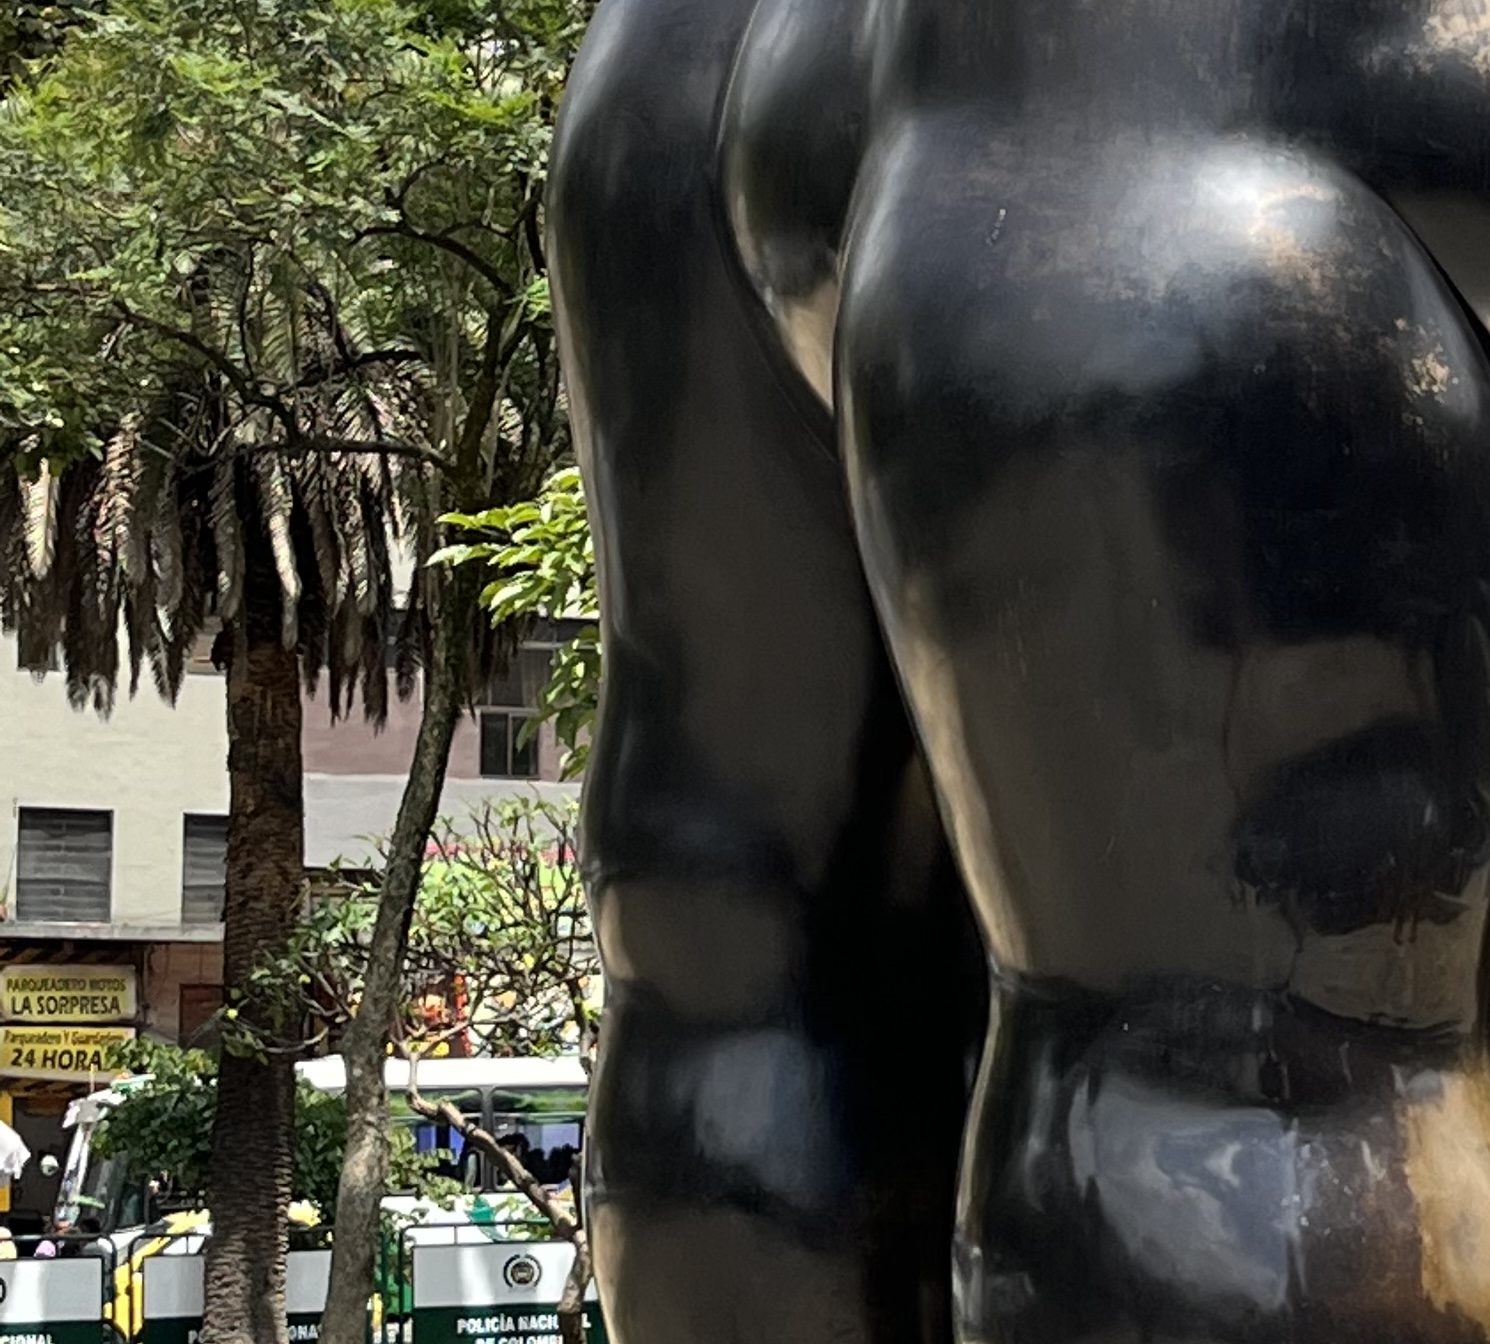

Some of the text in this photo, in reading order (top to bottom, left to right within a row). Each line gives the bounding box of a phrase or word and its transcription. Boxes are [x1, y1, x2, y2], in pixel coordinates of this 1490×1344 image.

[6, 978, 126, 992] PARQUEADERO MOTOS
[11, 996, 121, 1015] LA SORPRESA
[11, 1048, 109, 1071] 24 HORA
[457, 1313, 515, 1334] POLICÍA
